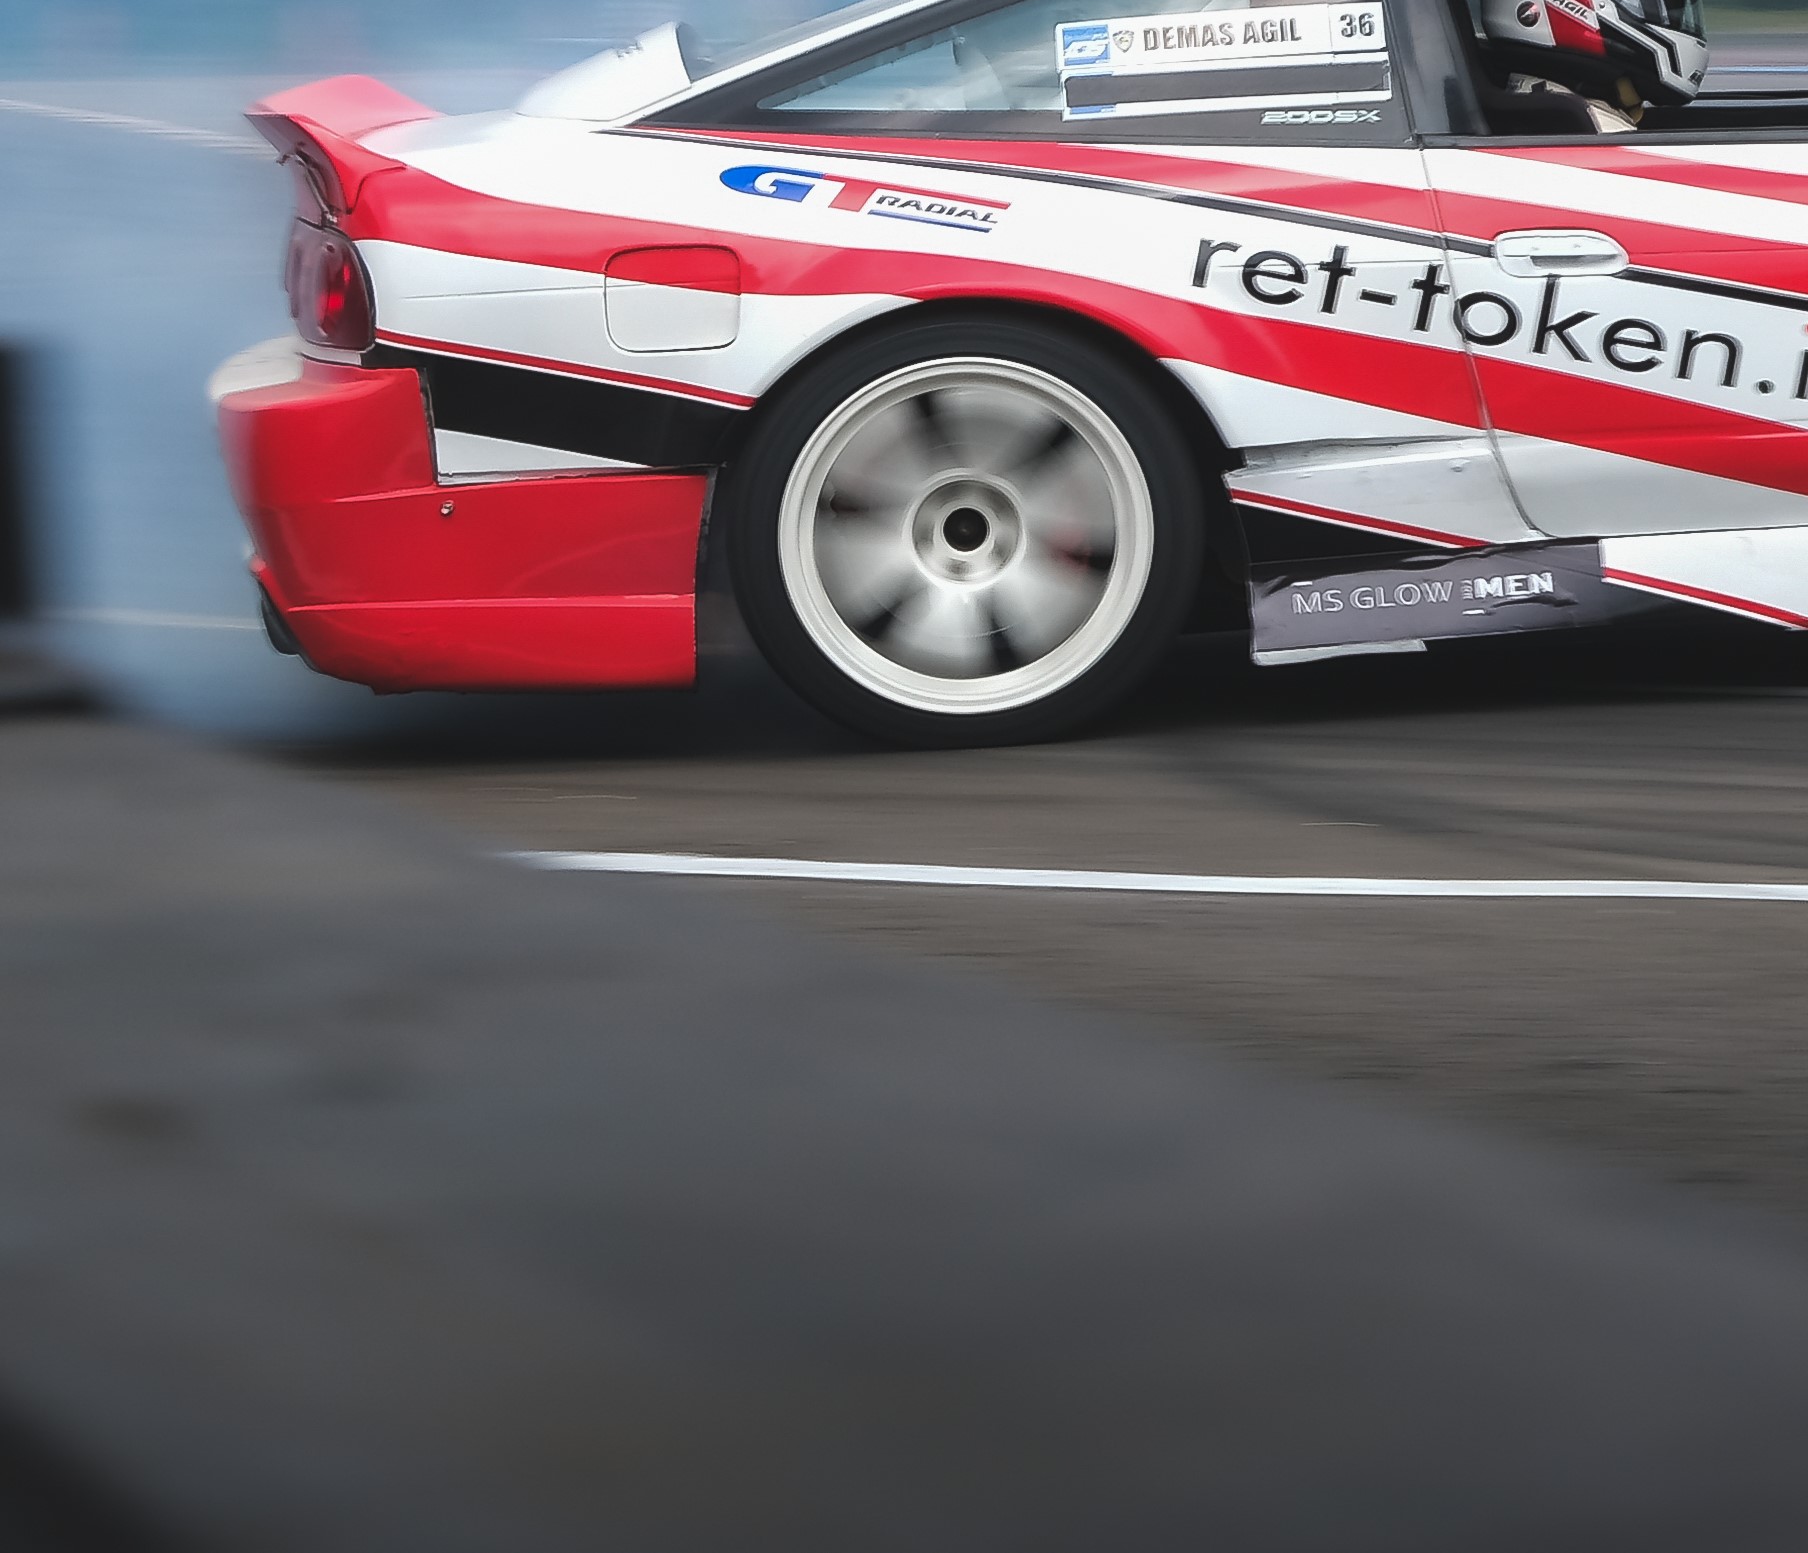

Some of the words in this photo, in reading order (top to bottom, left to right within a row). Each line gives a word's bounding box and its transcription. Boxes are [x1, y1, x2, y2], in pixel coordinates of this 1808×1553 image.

[1143, 22, 1236, 52] DEMAS
[1243, 18, 1303, 45] AGIL
[1339, 12, 1376, 38] 36
[1259, 109, 1383, 125] 200SX
[719, 164, 1011, 212] GT
[875, 194, 998, 224] RADIAL
[1291, 588, 1344, 615] MS
[1350, 580, 1453, 610] GLOW
[1473, 570, 1555, 599] MEN
